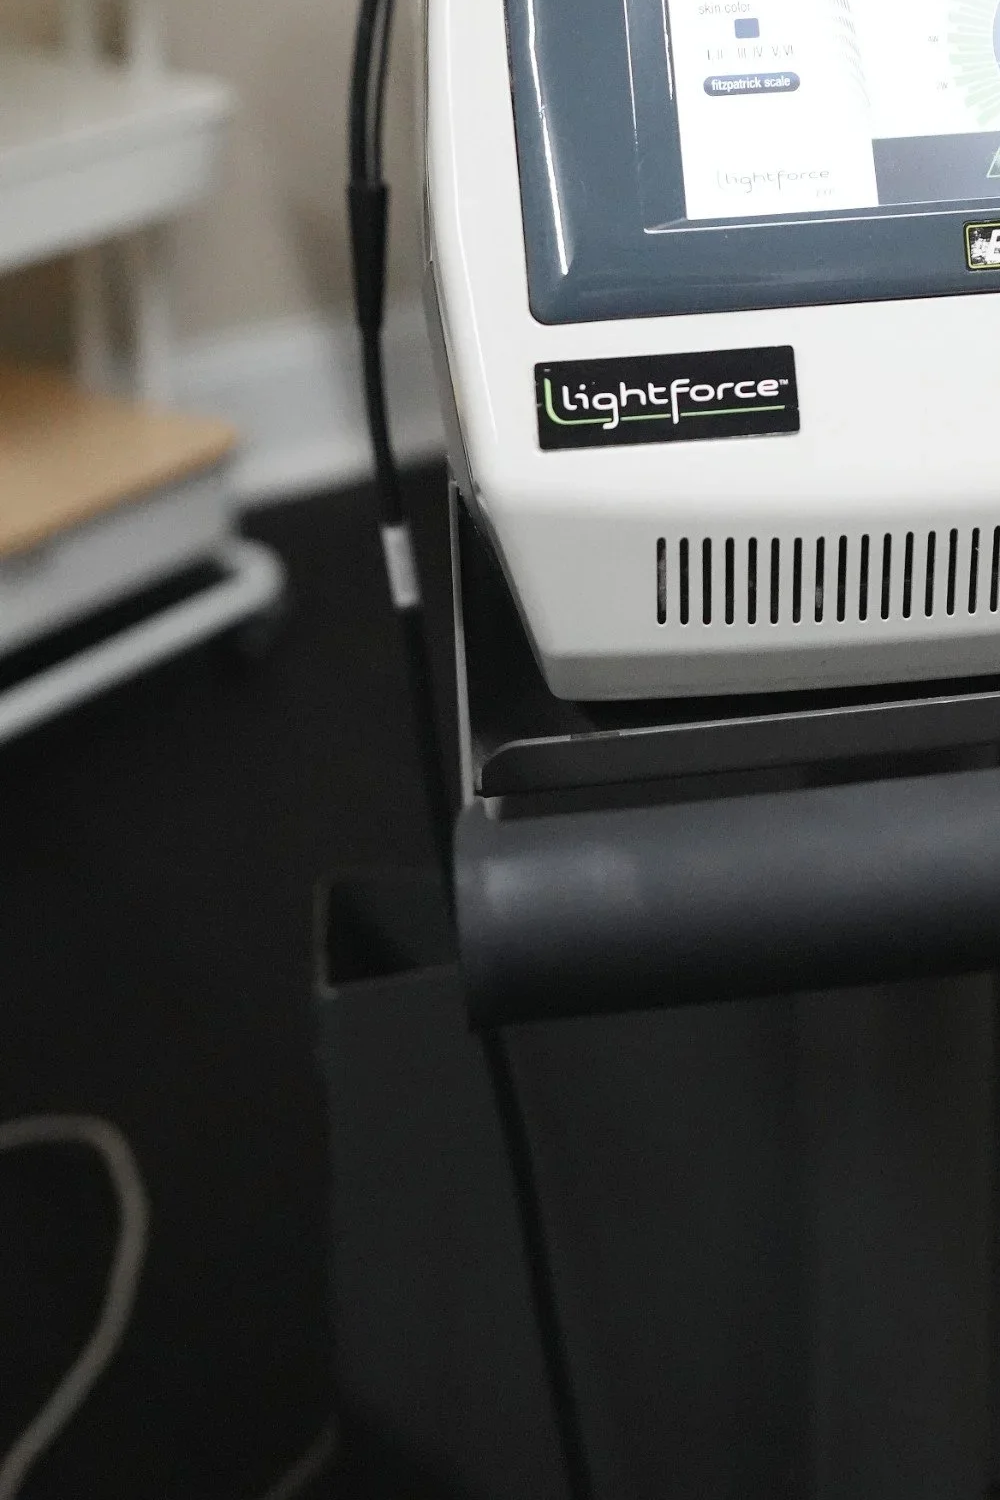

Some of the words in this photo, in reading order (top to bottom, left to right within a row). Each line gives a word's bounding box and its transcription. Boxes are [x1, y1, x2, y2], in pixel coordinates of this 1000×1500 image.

[697, 1, 721, 15] skin
[724, 1, 752, 14] color
[711, 74, 762, 93] fitzpatrick
[764, 74, 791, 89] scale
